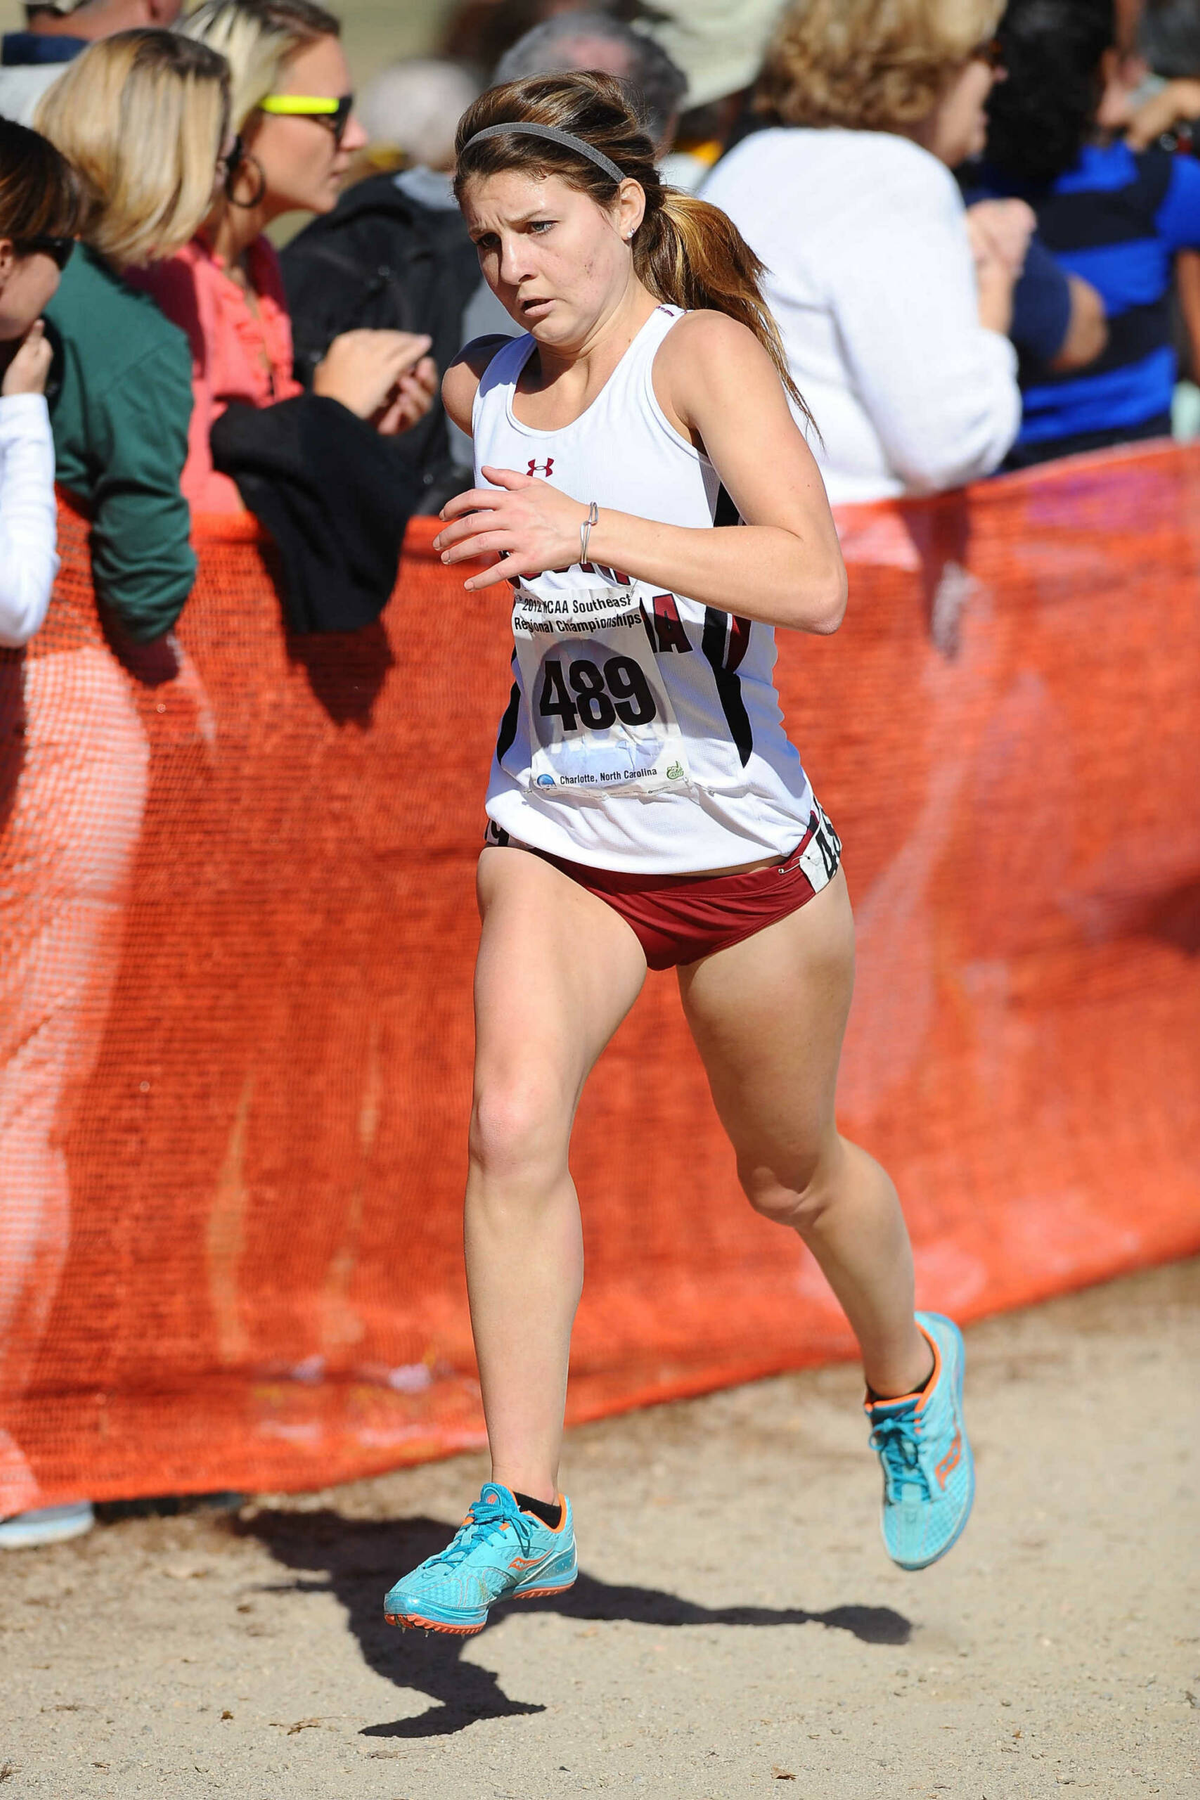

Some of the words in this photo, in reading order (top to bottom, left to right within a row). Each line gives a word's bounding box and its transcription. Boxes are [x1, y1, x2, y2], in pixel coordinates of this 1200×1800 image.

[522, 598, 542, 613] 2012
[572, 593, 632, 613] Southeast
[514, 617, 554, 633] Regional
[555, 613, 642, 633] Championships
[539, 656, 657, 731] 489
[559, 774, 598, 785] Charlotte,
[600, 771, 622, 782] North
[624, 768, 658, 779] Carolina
